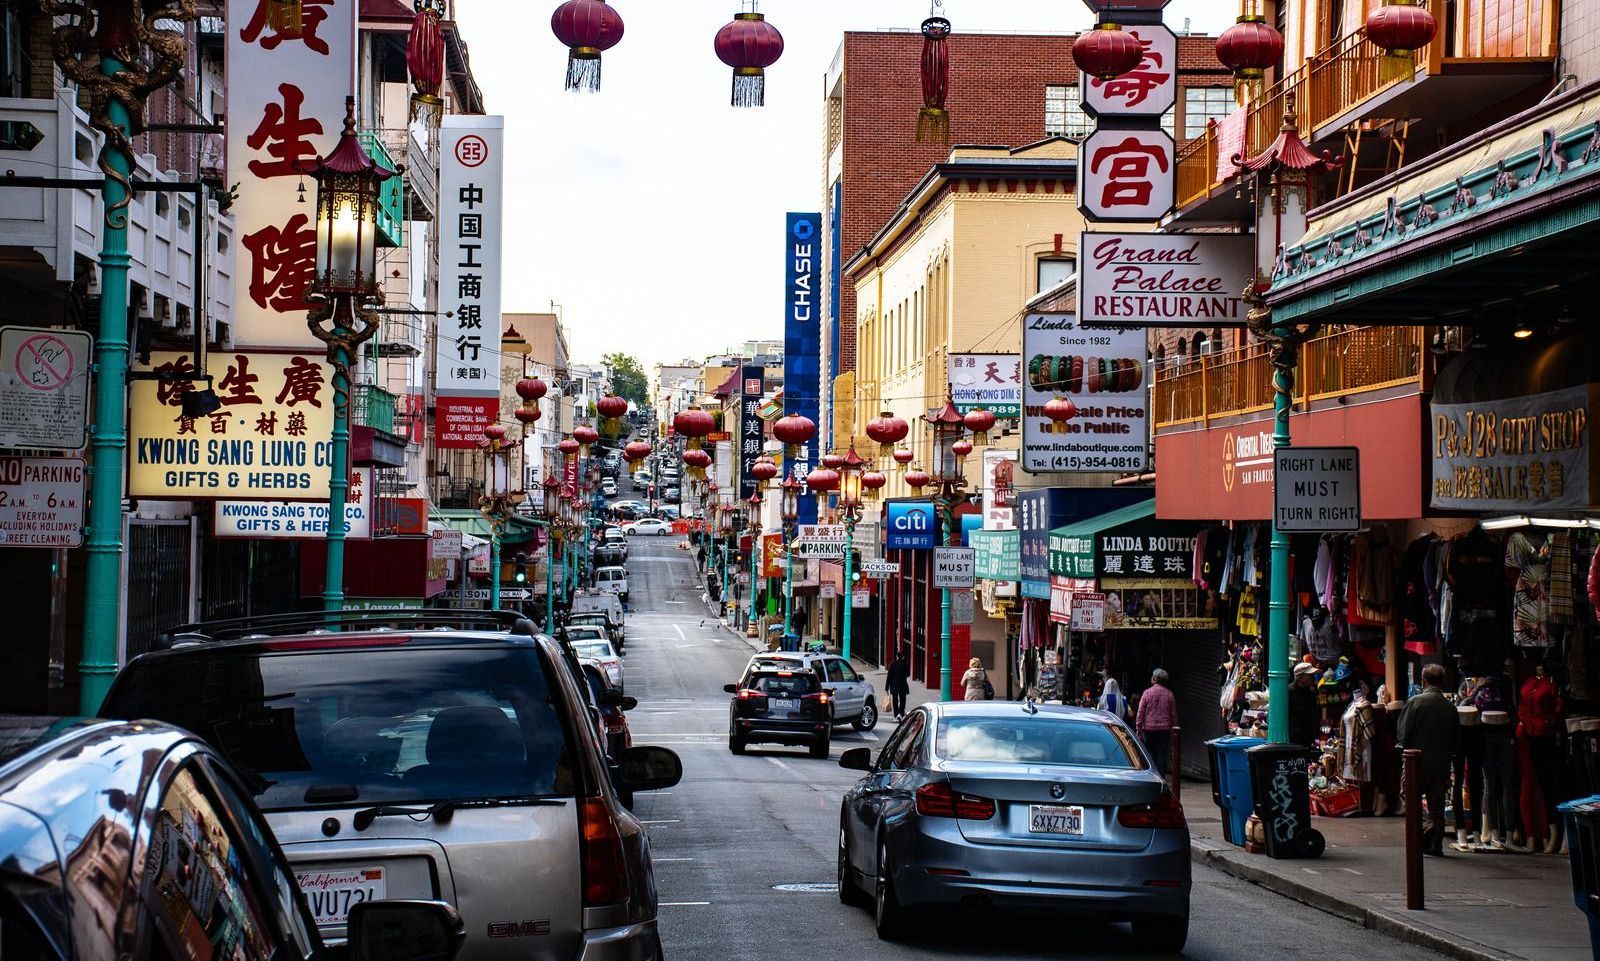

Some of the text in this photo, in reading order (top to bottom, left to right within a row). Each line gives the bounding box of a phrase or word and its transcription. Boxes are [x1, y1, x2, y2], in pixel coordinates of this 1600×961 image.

[1093, 238, 1200, 270] Grand
[456, 183, 483, 361] 中国工商银行
[795, 244, 811, 320] CHASE
[1112, 266, 1222, 292] Palace
[1094, 296, 1242, 318] RESTAURANT
[1029, 316, 1074, 330] Linda
[1060, 336, 1086, 345] Since
[954, 357, 976, 368] 香港
[955, 389, 975, 400] HONG
[977, 389, 998, 400] KONG
[1001, 390, 1014, 400] DIM
[1105, 405, 1145, 418] Price
[1083, 421, 1130, 434] Public
[1500, 417, 1537, 455] GIFT
[1541, 408, 1586, 452] SHOP
[138, 438, 199, 465] KWONG
[208, 439, 253, 466] SANG
[262, 440, 306, 467] LUNG
[1026, 443, 1145, 456] www.lindaboutique.com
[1033, 457, 1143, 470] Tel: (415)-954-0816
[1280, 458, 1353, 471] RIGHT LANE
[24, 465, 81, 483] PARKING
[166, 471, 311, 488] GIFTS & HERBS
[1242, 471, 1251, 484] SAN
[1295, 481, 1339, 496] MUST
[11, 499, 28, 508] A.M.
[48, 492, 57, 508] 6
[60, 500, 78, 509] A.M.
[16, 511, 57, 520] EVERYDAY
[223, 505, 366, 519] KWONG SANG TON CO.
[1280, 507, 1356, 520] TURN RIGHT
[40, 522, 78, 531] HOLIDAYS
[237, 519, 352, 532] GIFTS & HERS
[895, 512, 926, 530] citi
[5, 533, 71, 544] TREET CLEANING
[434, 530, 441, 539] NO
[808, 543, 847, 554] PARKING
[1102, 536, 1143, 551] LINDA
[861, 563, 898, 571] JACKSON
[939, 563, 969, 572] MUST
[955, 575, 973, 583] RIGHT
[440, 590, 488, 599] JACSON
[500, 590, 510, 598] ONE
[1073, 599, 1081, 607] NO
[1033, 815, 1080, 830] 6XXZ730
[300, 874, 362, 889] California
[488, 920, 551, 938] GMC
